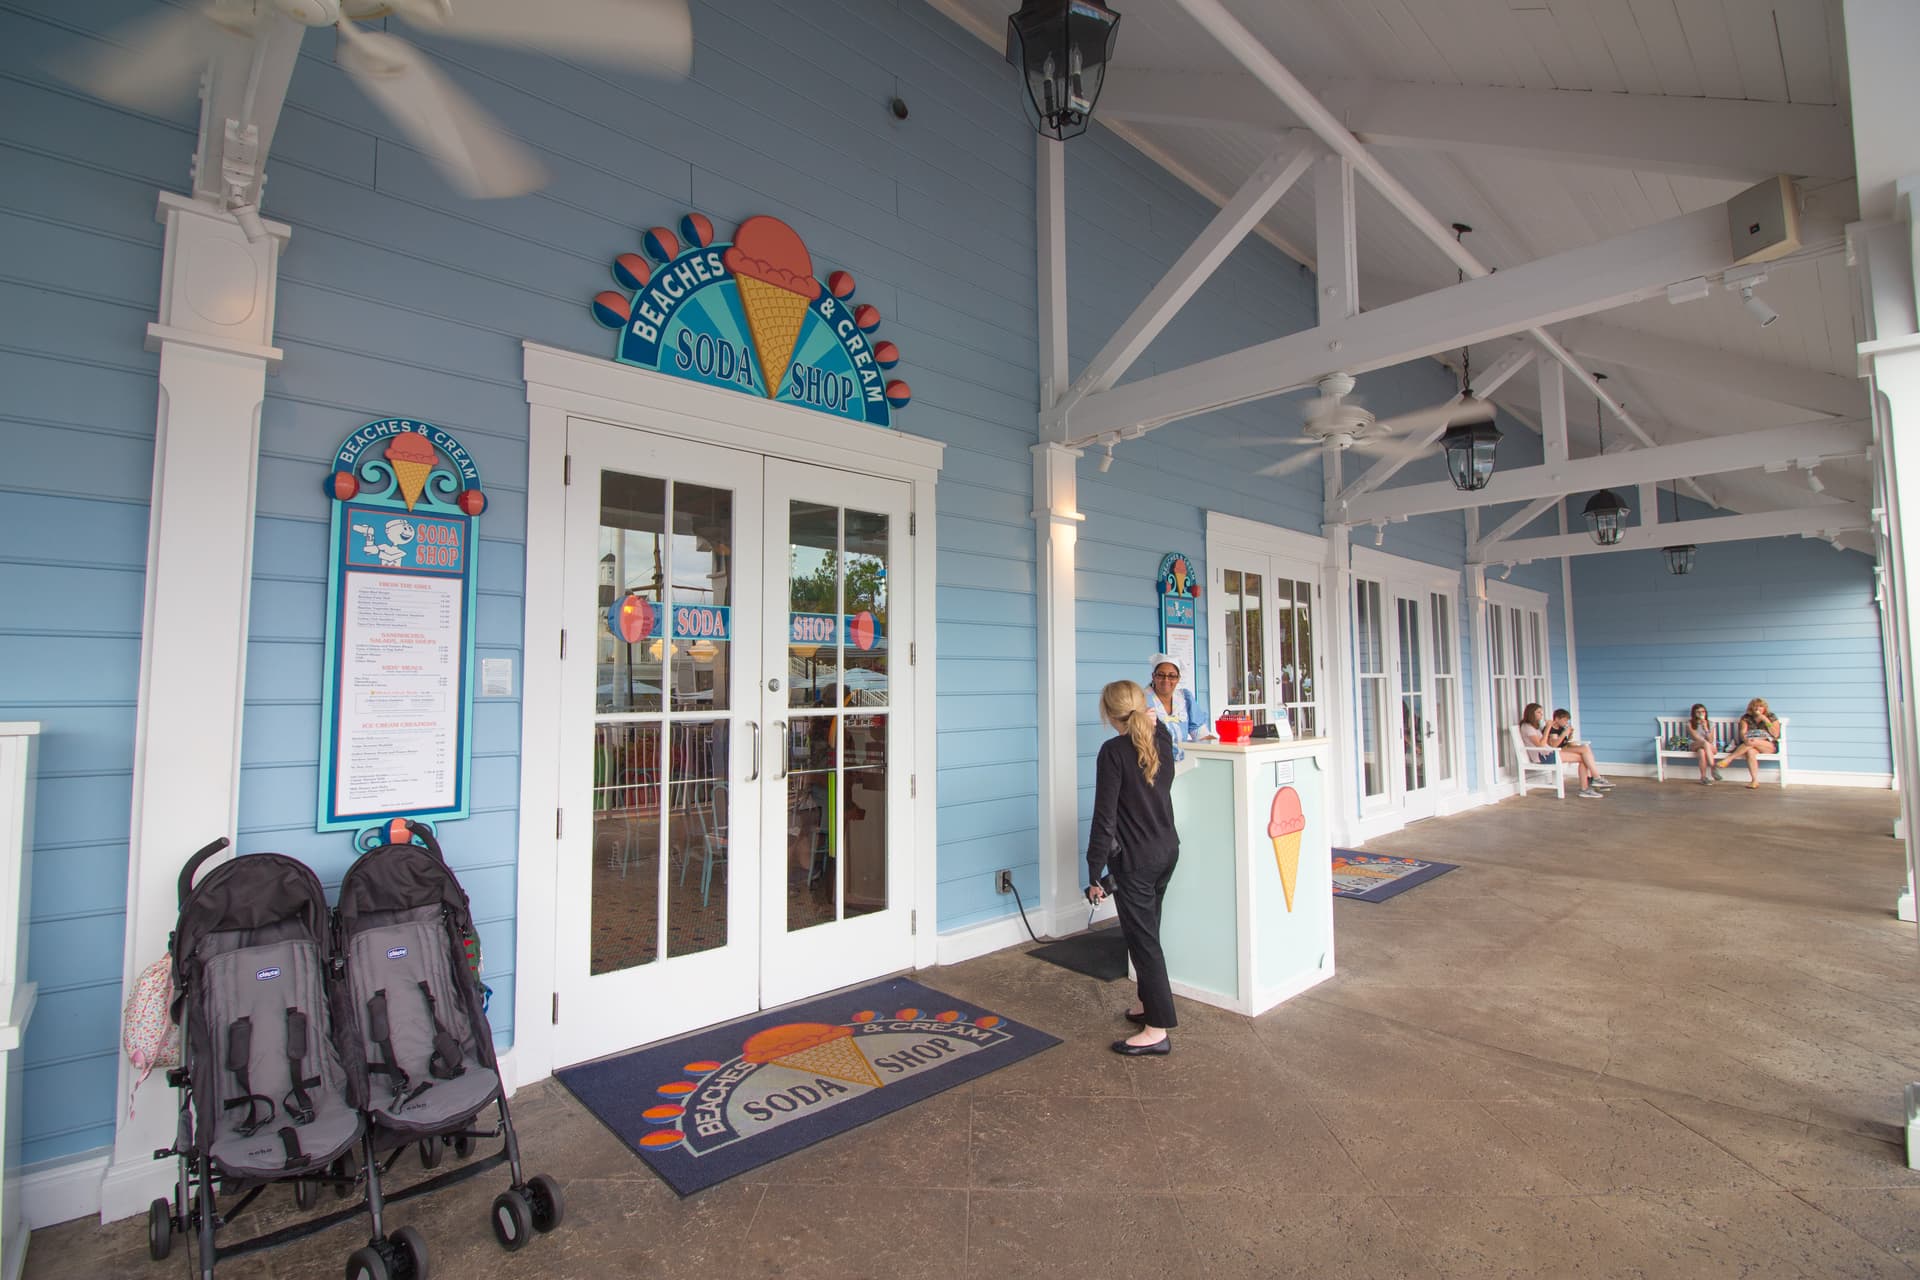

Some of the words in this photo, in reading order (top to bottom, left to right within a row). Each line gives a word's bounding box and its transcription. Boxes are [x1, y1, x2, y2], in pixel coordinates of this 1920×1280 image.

[632, 251, 725, 345] BEACHES
[819, 298, 835, 319] &
[837, 318, 884, 404] CREAM
[674, 327, 755, 387] SODA
[790, 362, 854, 412] SHOP
[339, 420, 411, 463] BEACHES
[417, 424, 428, 436] &
[434, 432, 477, 479] CREAM
[416, 523, 459, 546] SODA
[416, 545, 459, 567] SHOP
[677, 607, 725, 637] SODA
[793, 615, 834, 642] SHOP
[694, 1060, 758, 1137] BEACHES
[863, 1022, 884, 1034] &
[888, 1021, 993, 1042] CREAM
[742, 1078, 849, 1122] SODA
[874, 1037, 957, 1074] SHOP
